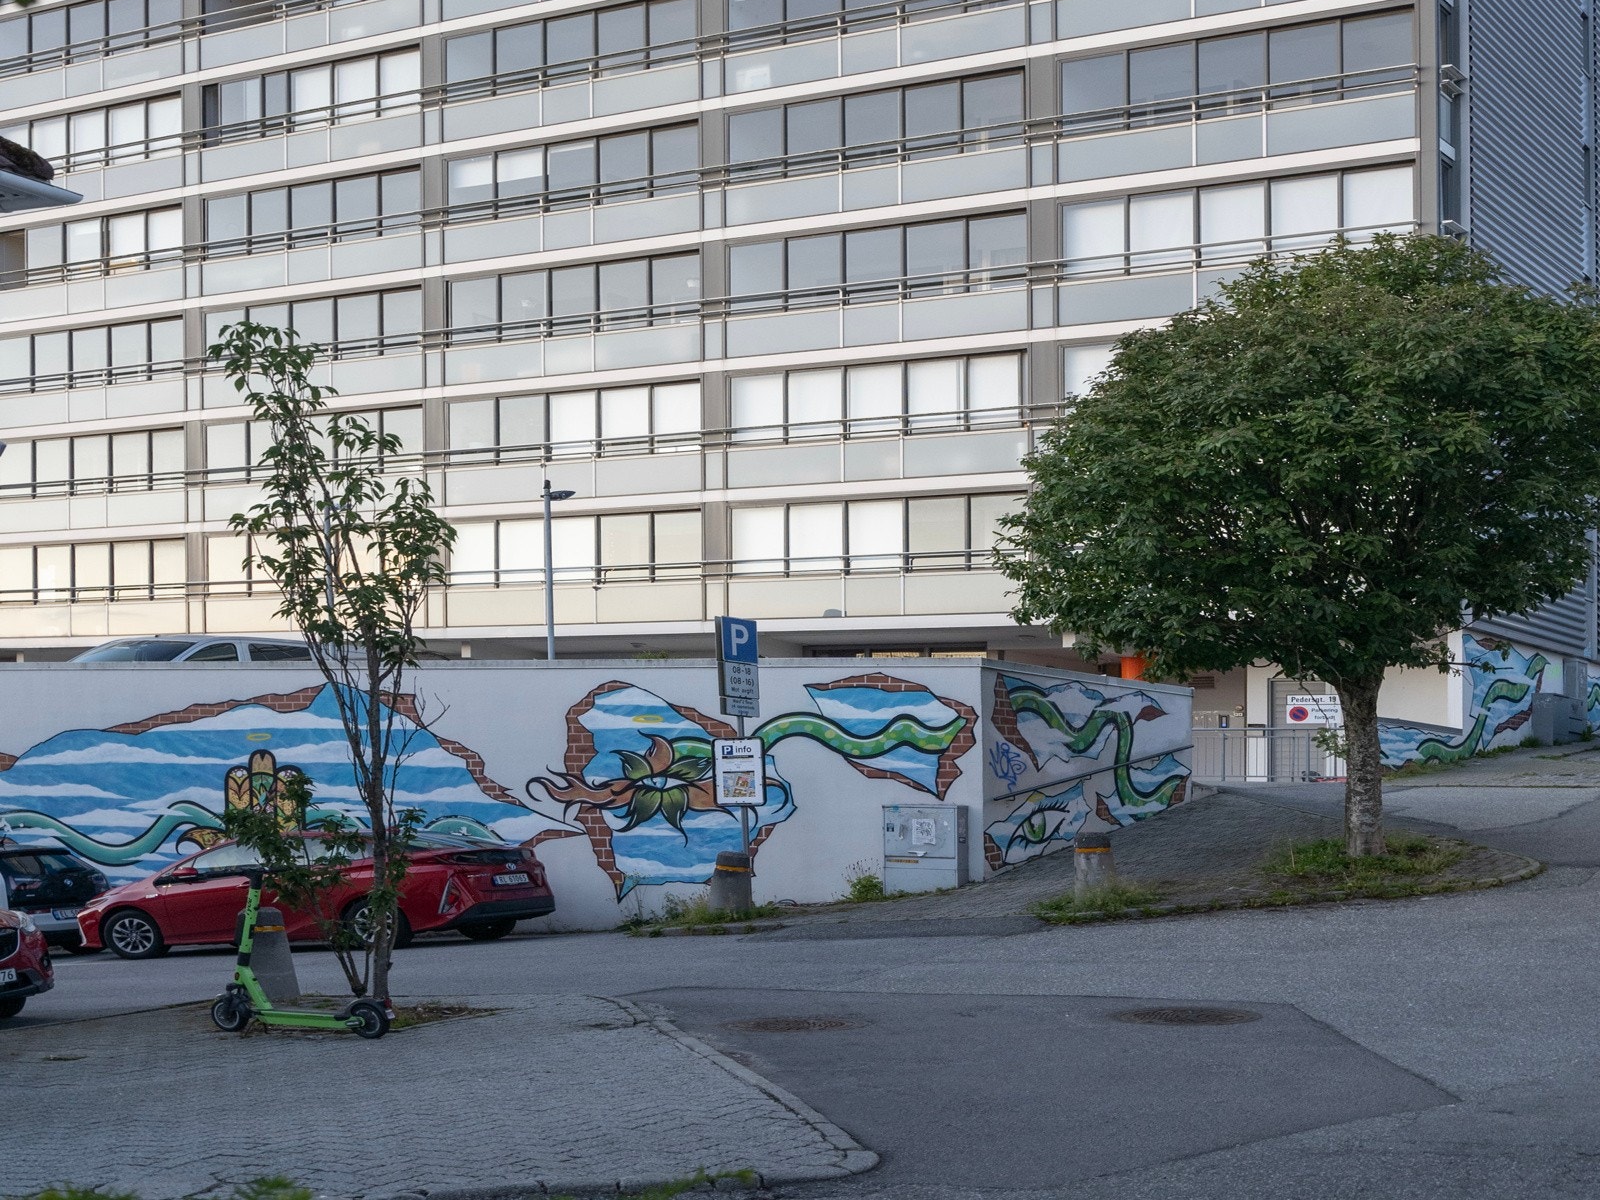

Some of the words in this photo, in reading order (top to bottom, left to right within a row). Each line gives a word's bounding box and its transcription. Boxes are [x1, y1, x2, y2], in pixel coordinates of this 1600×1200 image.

[730, 623, 748, 656] P
[730, 676, 754, 687] (08-16)
[735, 745, 752, 753] info
